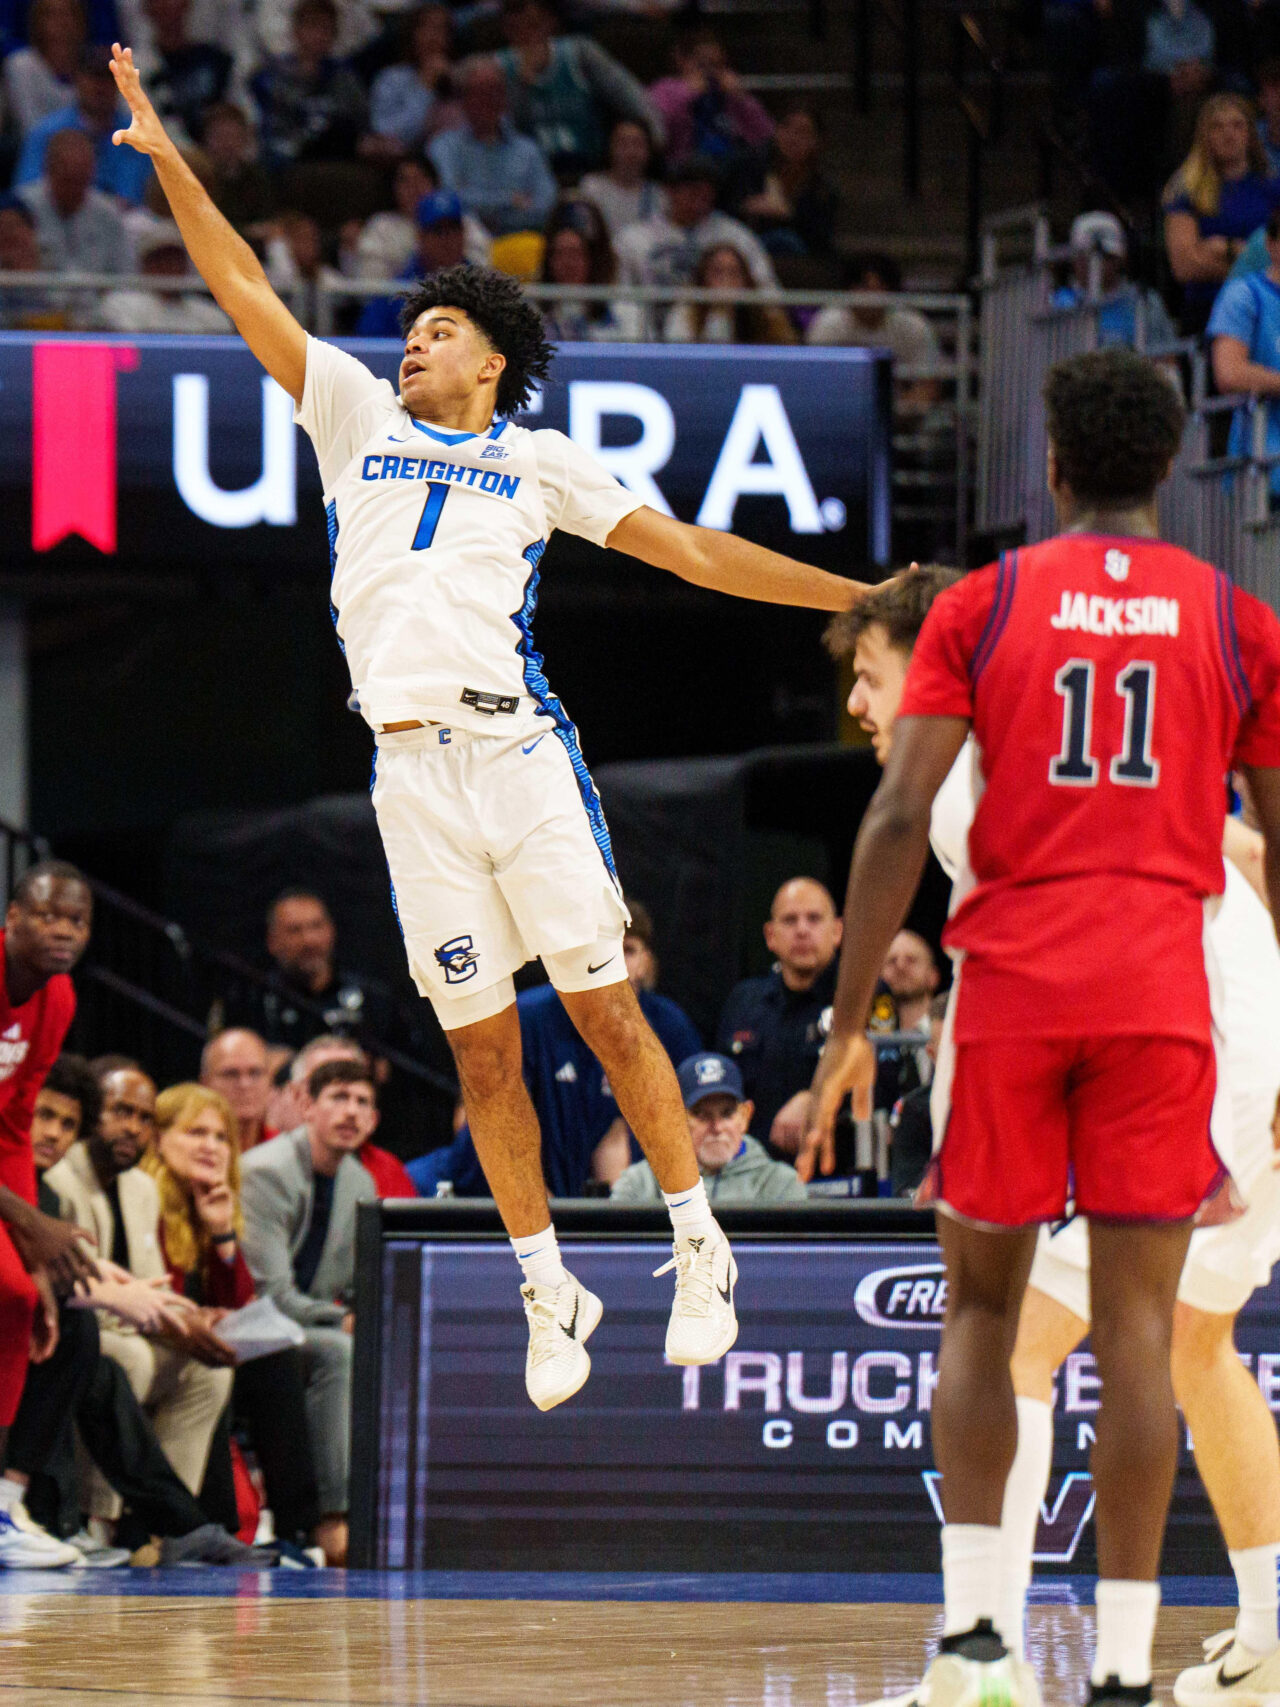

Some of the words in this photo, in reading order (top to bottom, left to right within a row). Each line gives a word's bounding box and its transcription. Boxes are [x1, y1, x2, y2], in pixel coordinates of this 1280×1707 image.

[481, 450, 510, 459] EAST
[486, 444, 505, 452] BIG
[361, 454, 522, 500] CREIGHTON
[410, 481, 451, 551] 1
[1050, 589, 1180, 637] JACKSON
[438, 728, 452, 745] C
[1048, 657, 1161, 789] 11
